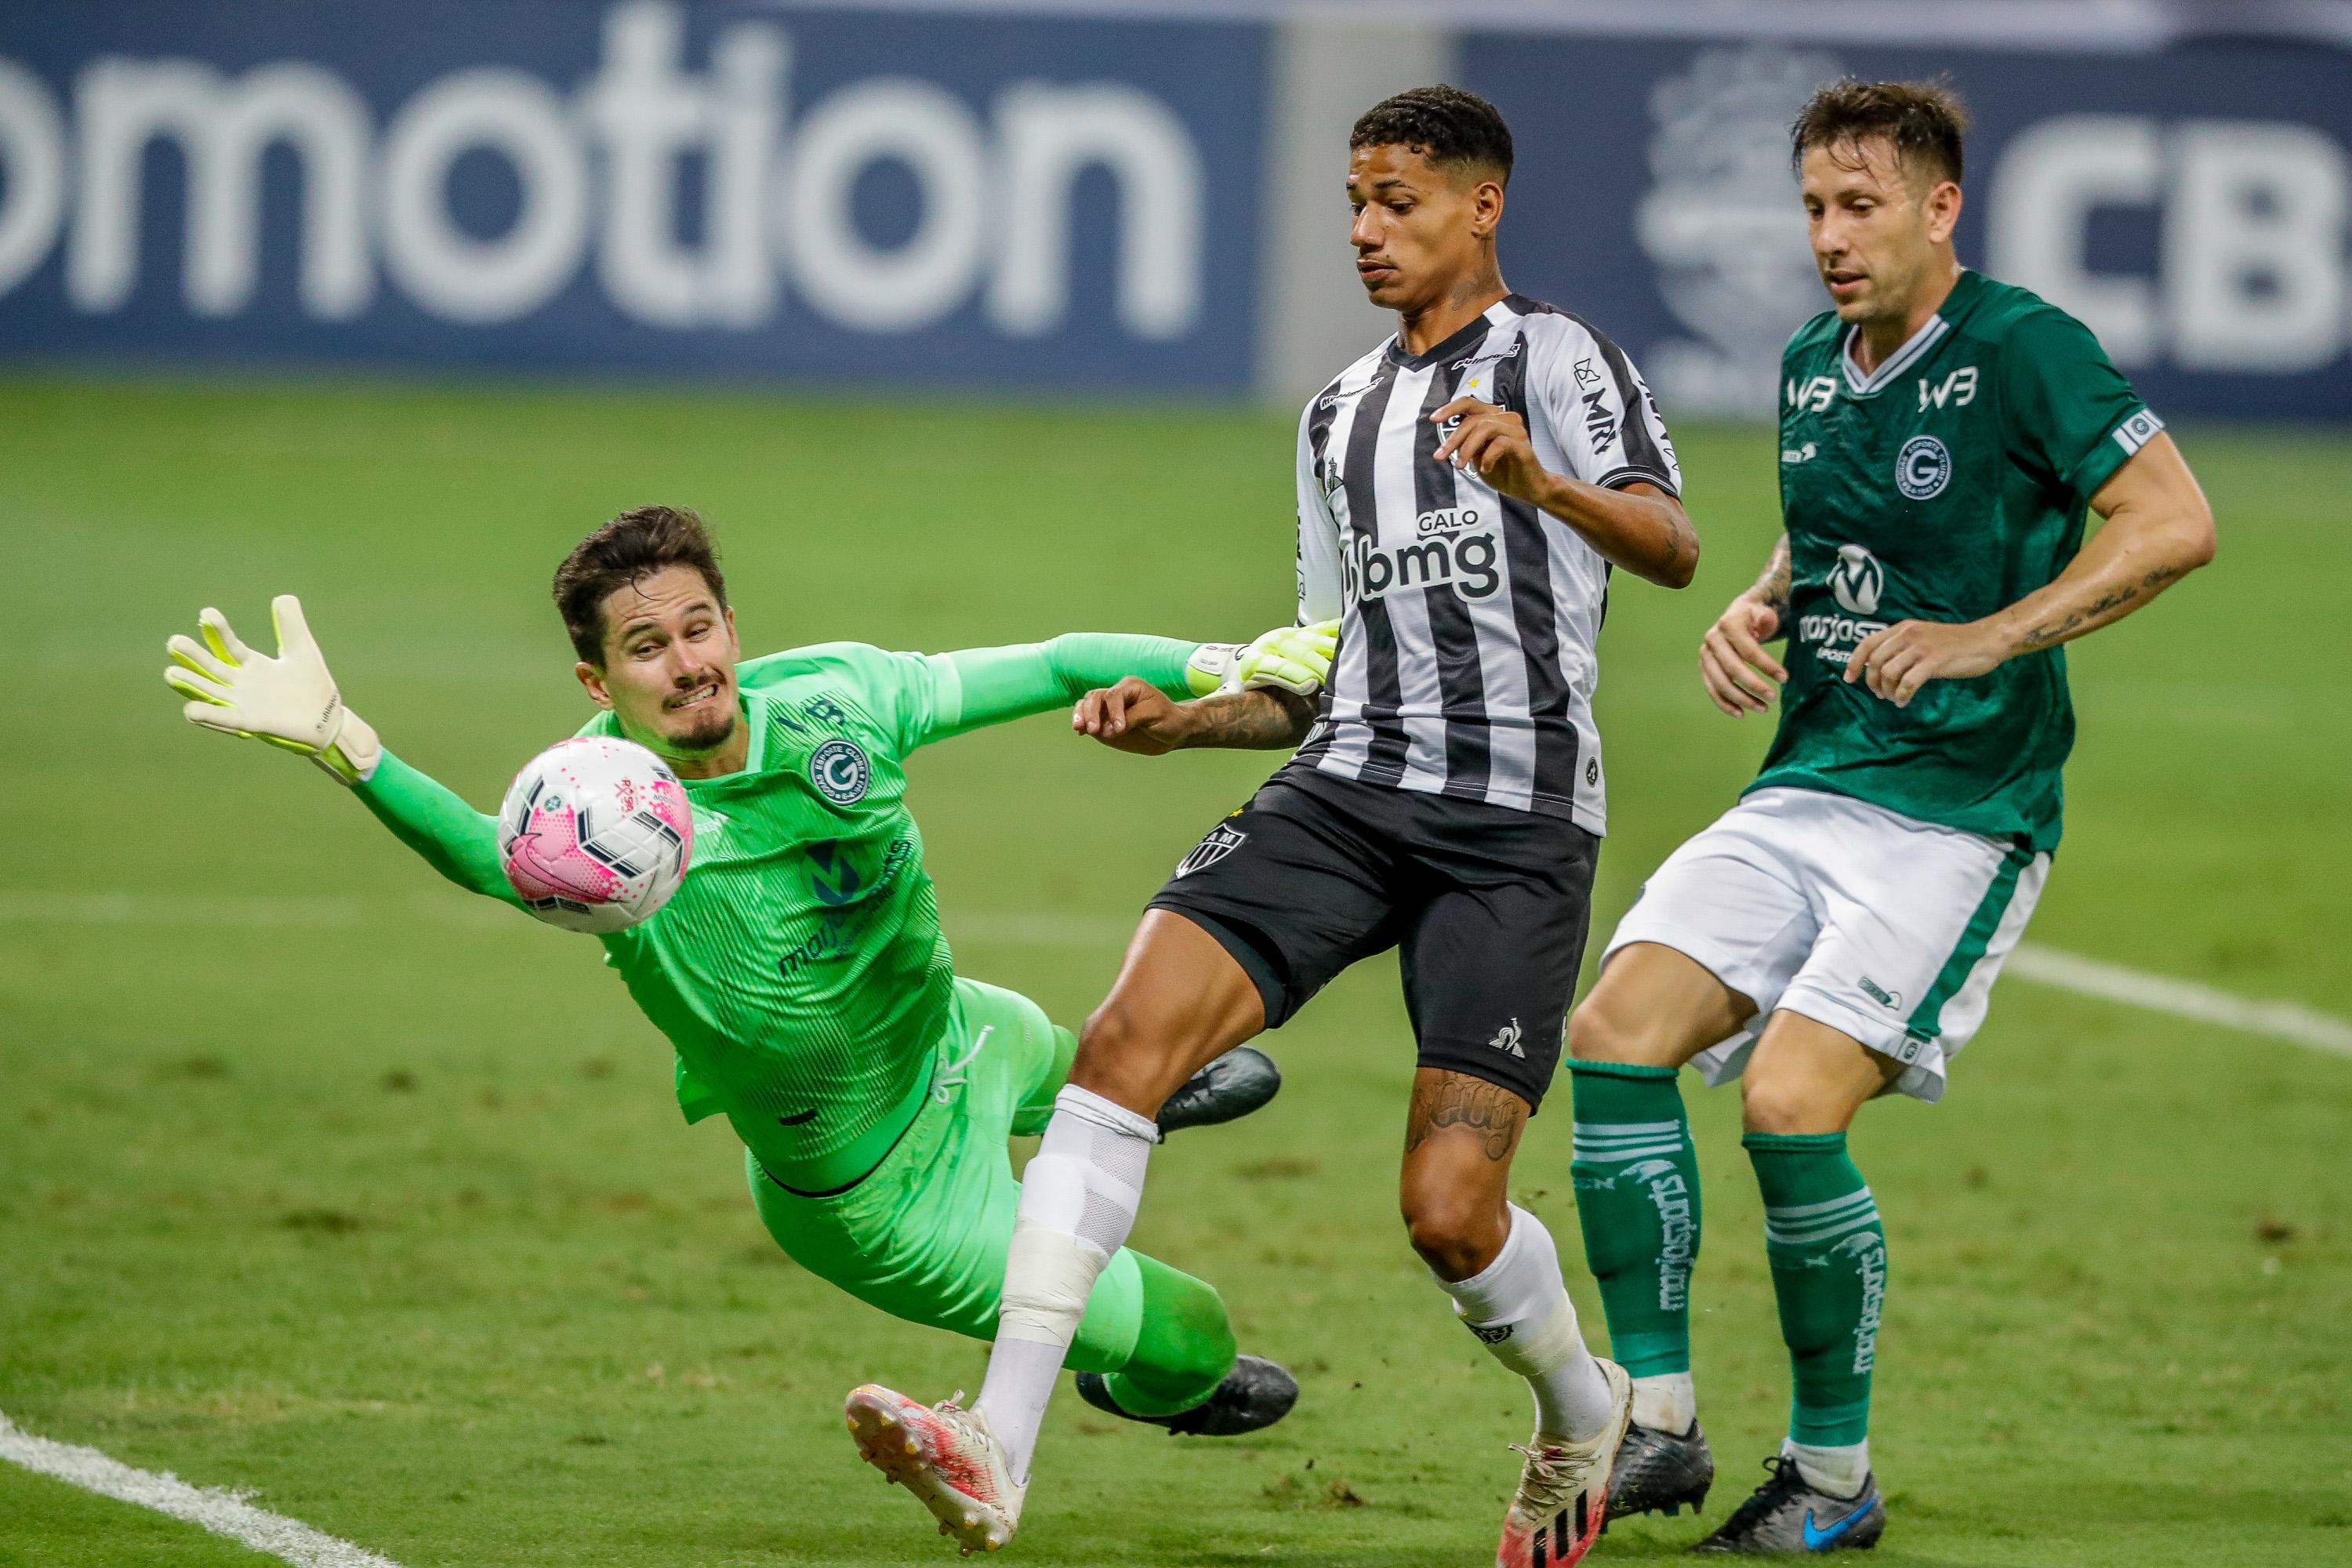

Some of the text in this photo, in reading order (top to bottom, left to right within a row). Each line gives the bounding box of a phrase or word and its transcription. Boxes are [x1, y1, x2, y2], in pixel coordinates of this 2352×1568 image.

[1419, 510, 1479, 531] GALO
[1362, 532, 1499, 598] bmg
[1648, 1174, 1697, 1312] marjosports
